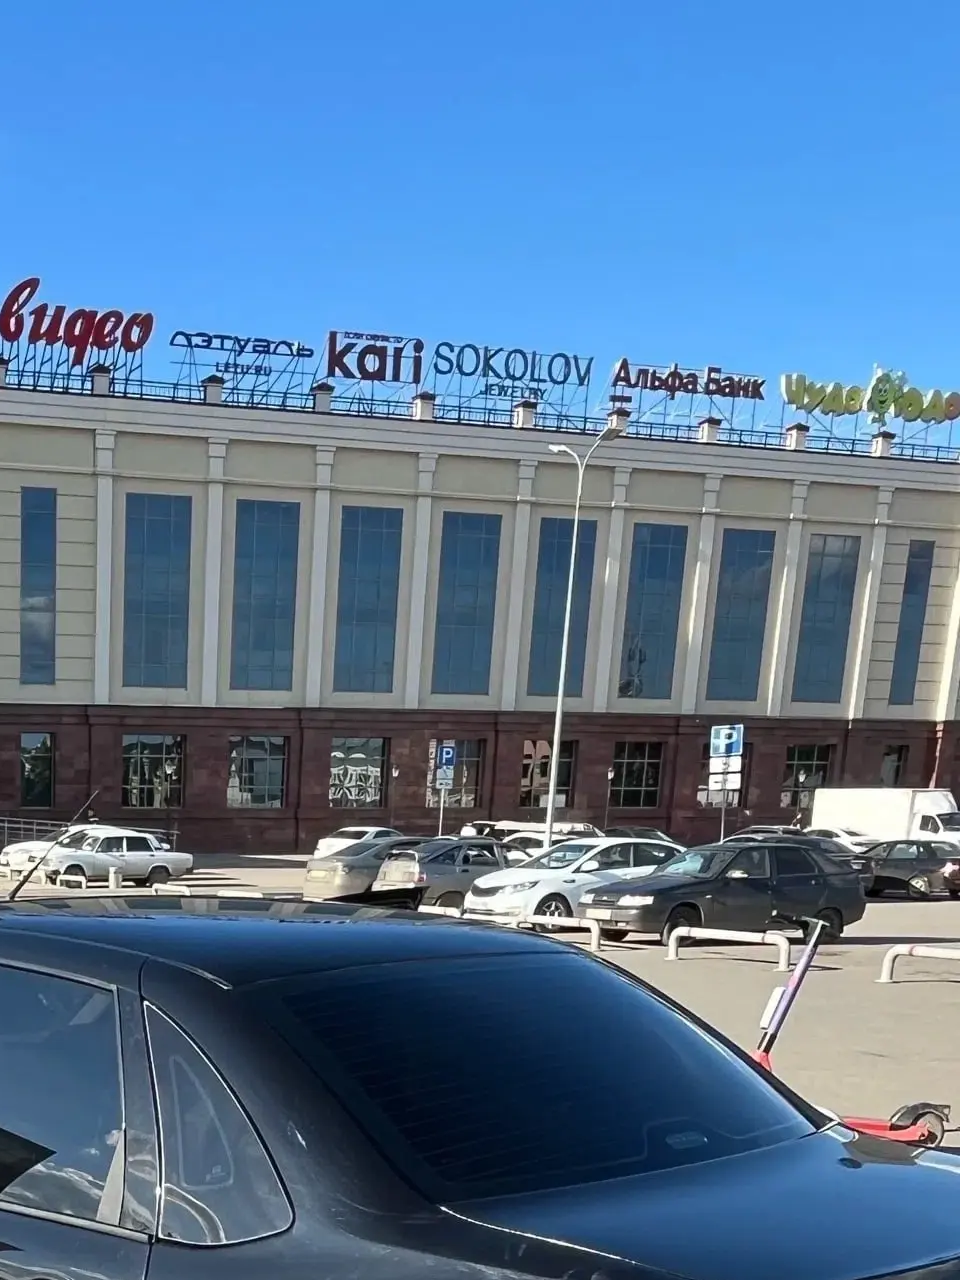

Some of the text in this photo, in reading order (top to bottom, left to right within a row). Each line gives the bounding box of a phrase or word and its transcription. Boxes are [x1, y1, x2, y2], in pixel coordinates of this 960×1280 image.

[327, 330, 425, 385] kari
[433, 341, 595, 387] SOKOLOV
[611, 357, 767, 401] Альфа Банк
[479, 383, 548, 401] JEWELRY
[442, 747, 453, 764] P
